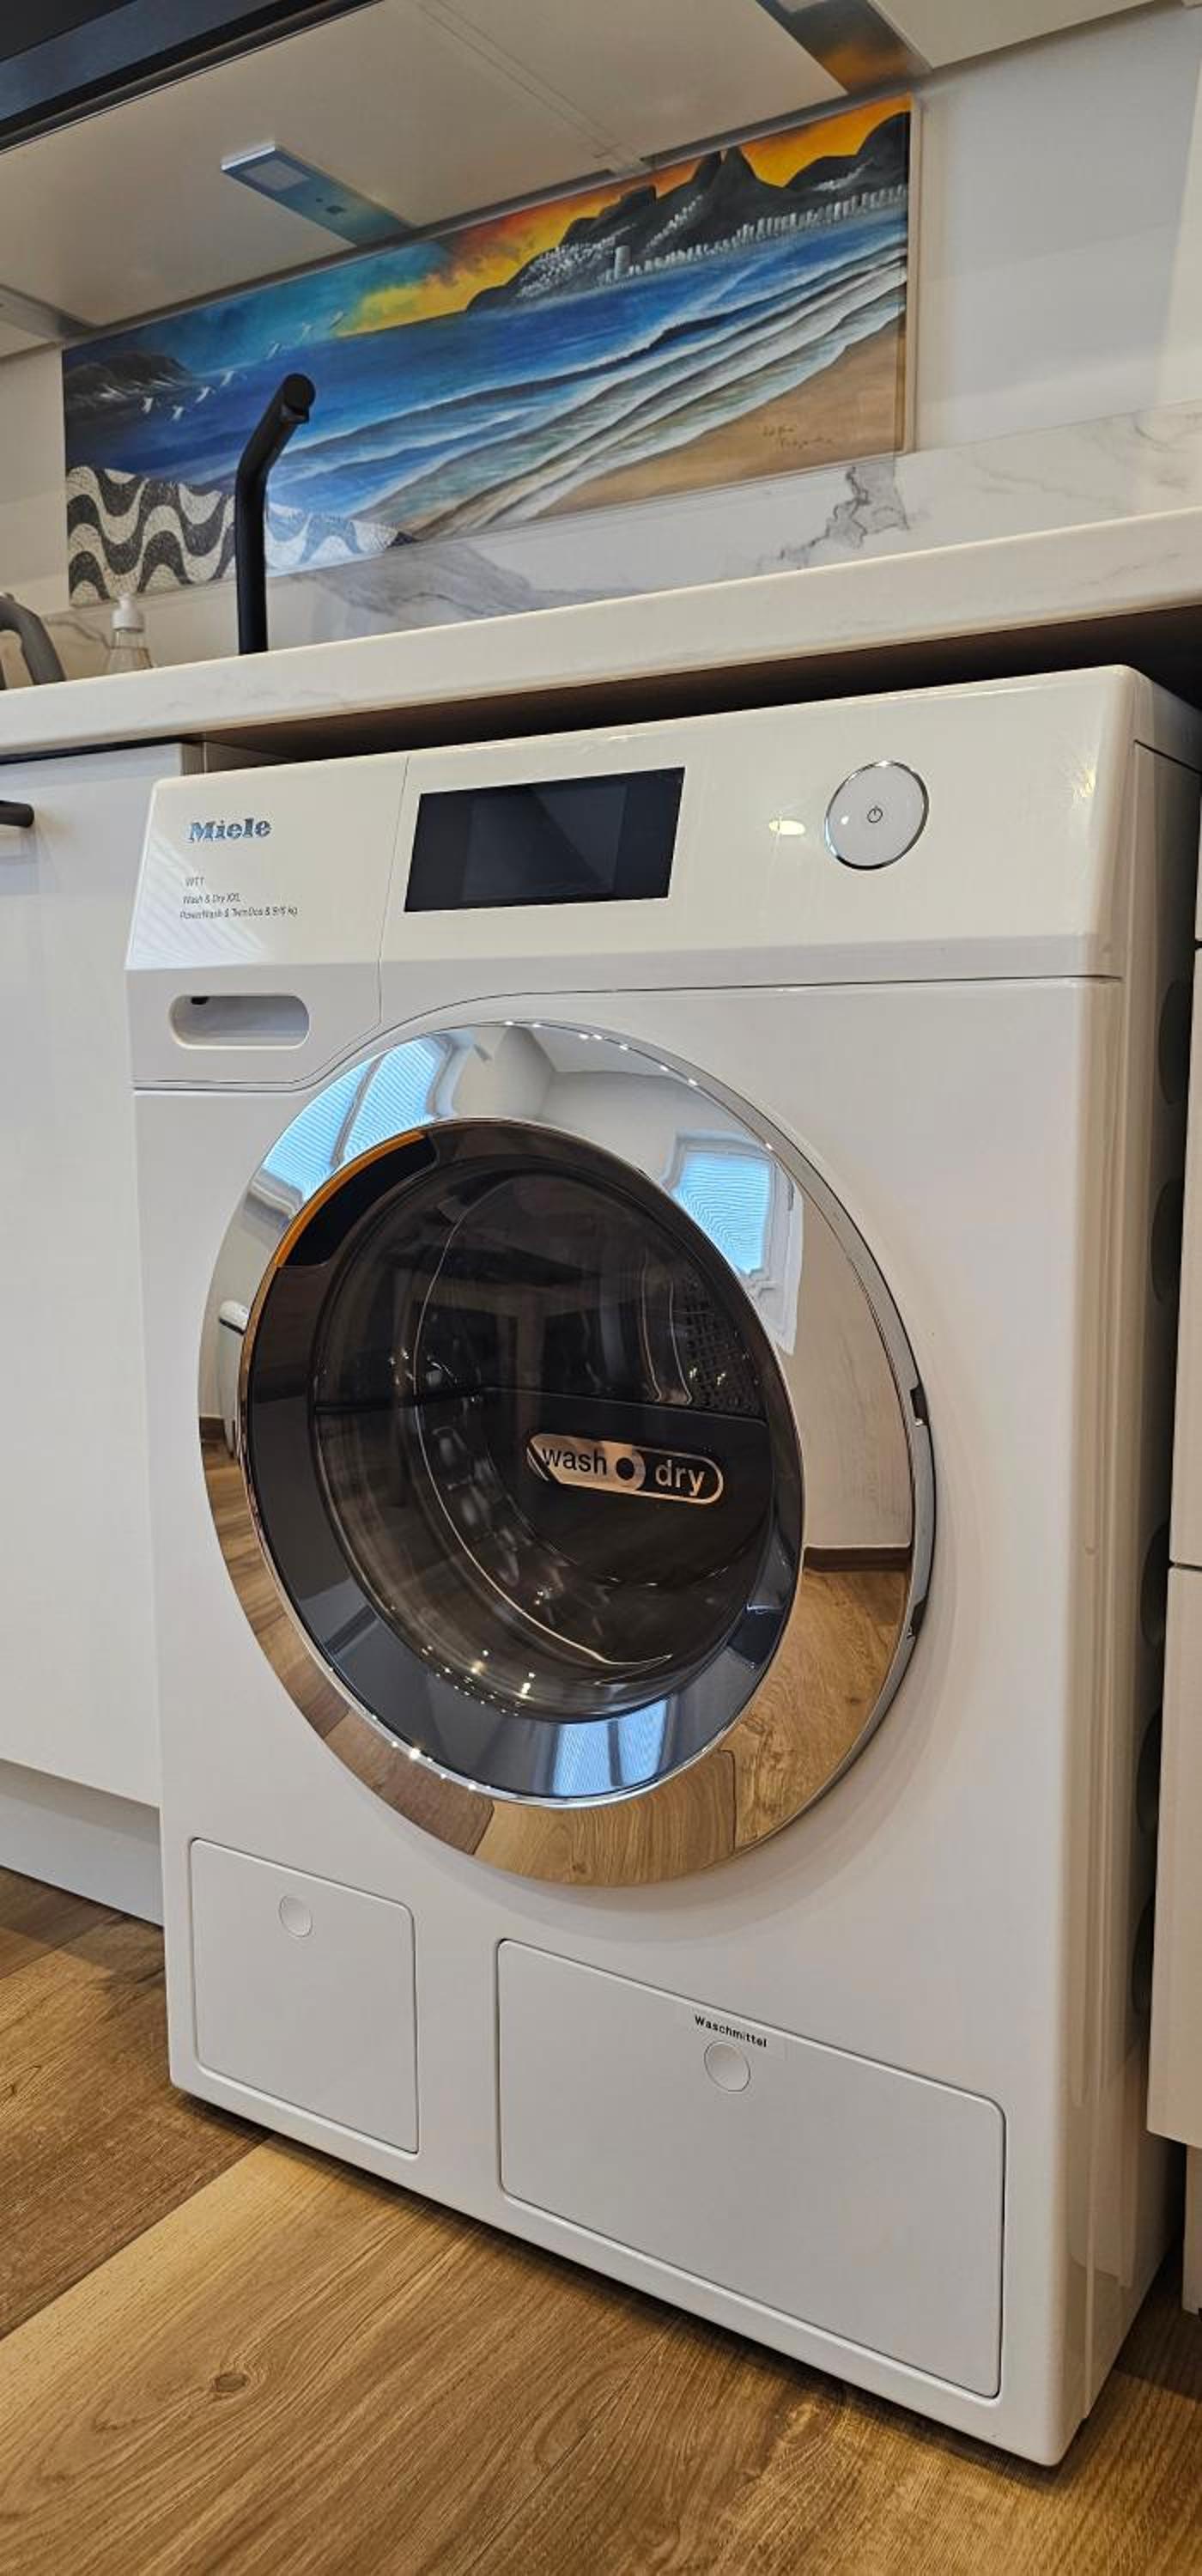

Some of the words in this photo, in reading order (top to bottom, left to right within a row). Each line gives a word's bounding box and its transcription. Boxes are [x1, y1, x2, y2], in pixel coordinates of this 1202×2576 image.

[188, 817, 273, 843] Miele
[183, 895, 203, 904] Wash
[212, 894, 225, 904] Dry
[542, 1449, 607, 1475] wash
[655, 1460, 705, 1496] dry
[695, 2014, 767, 2048] Waschmittel
